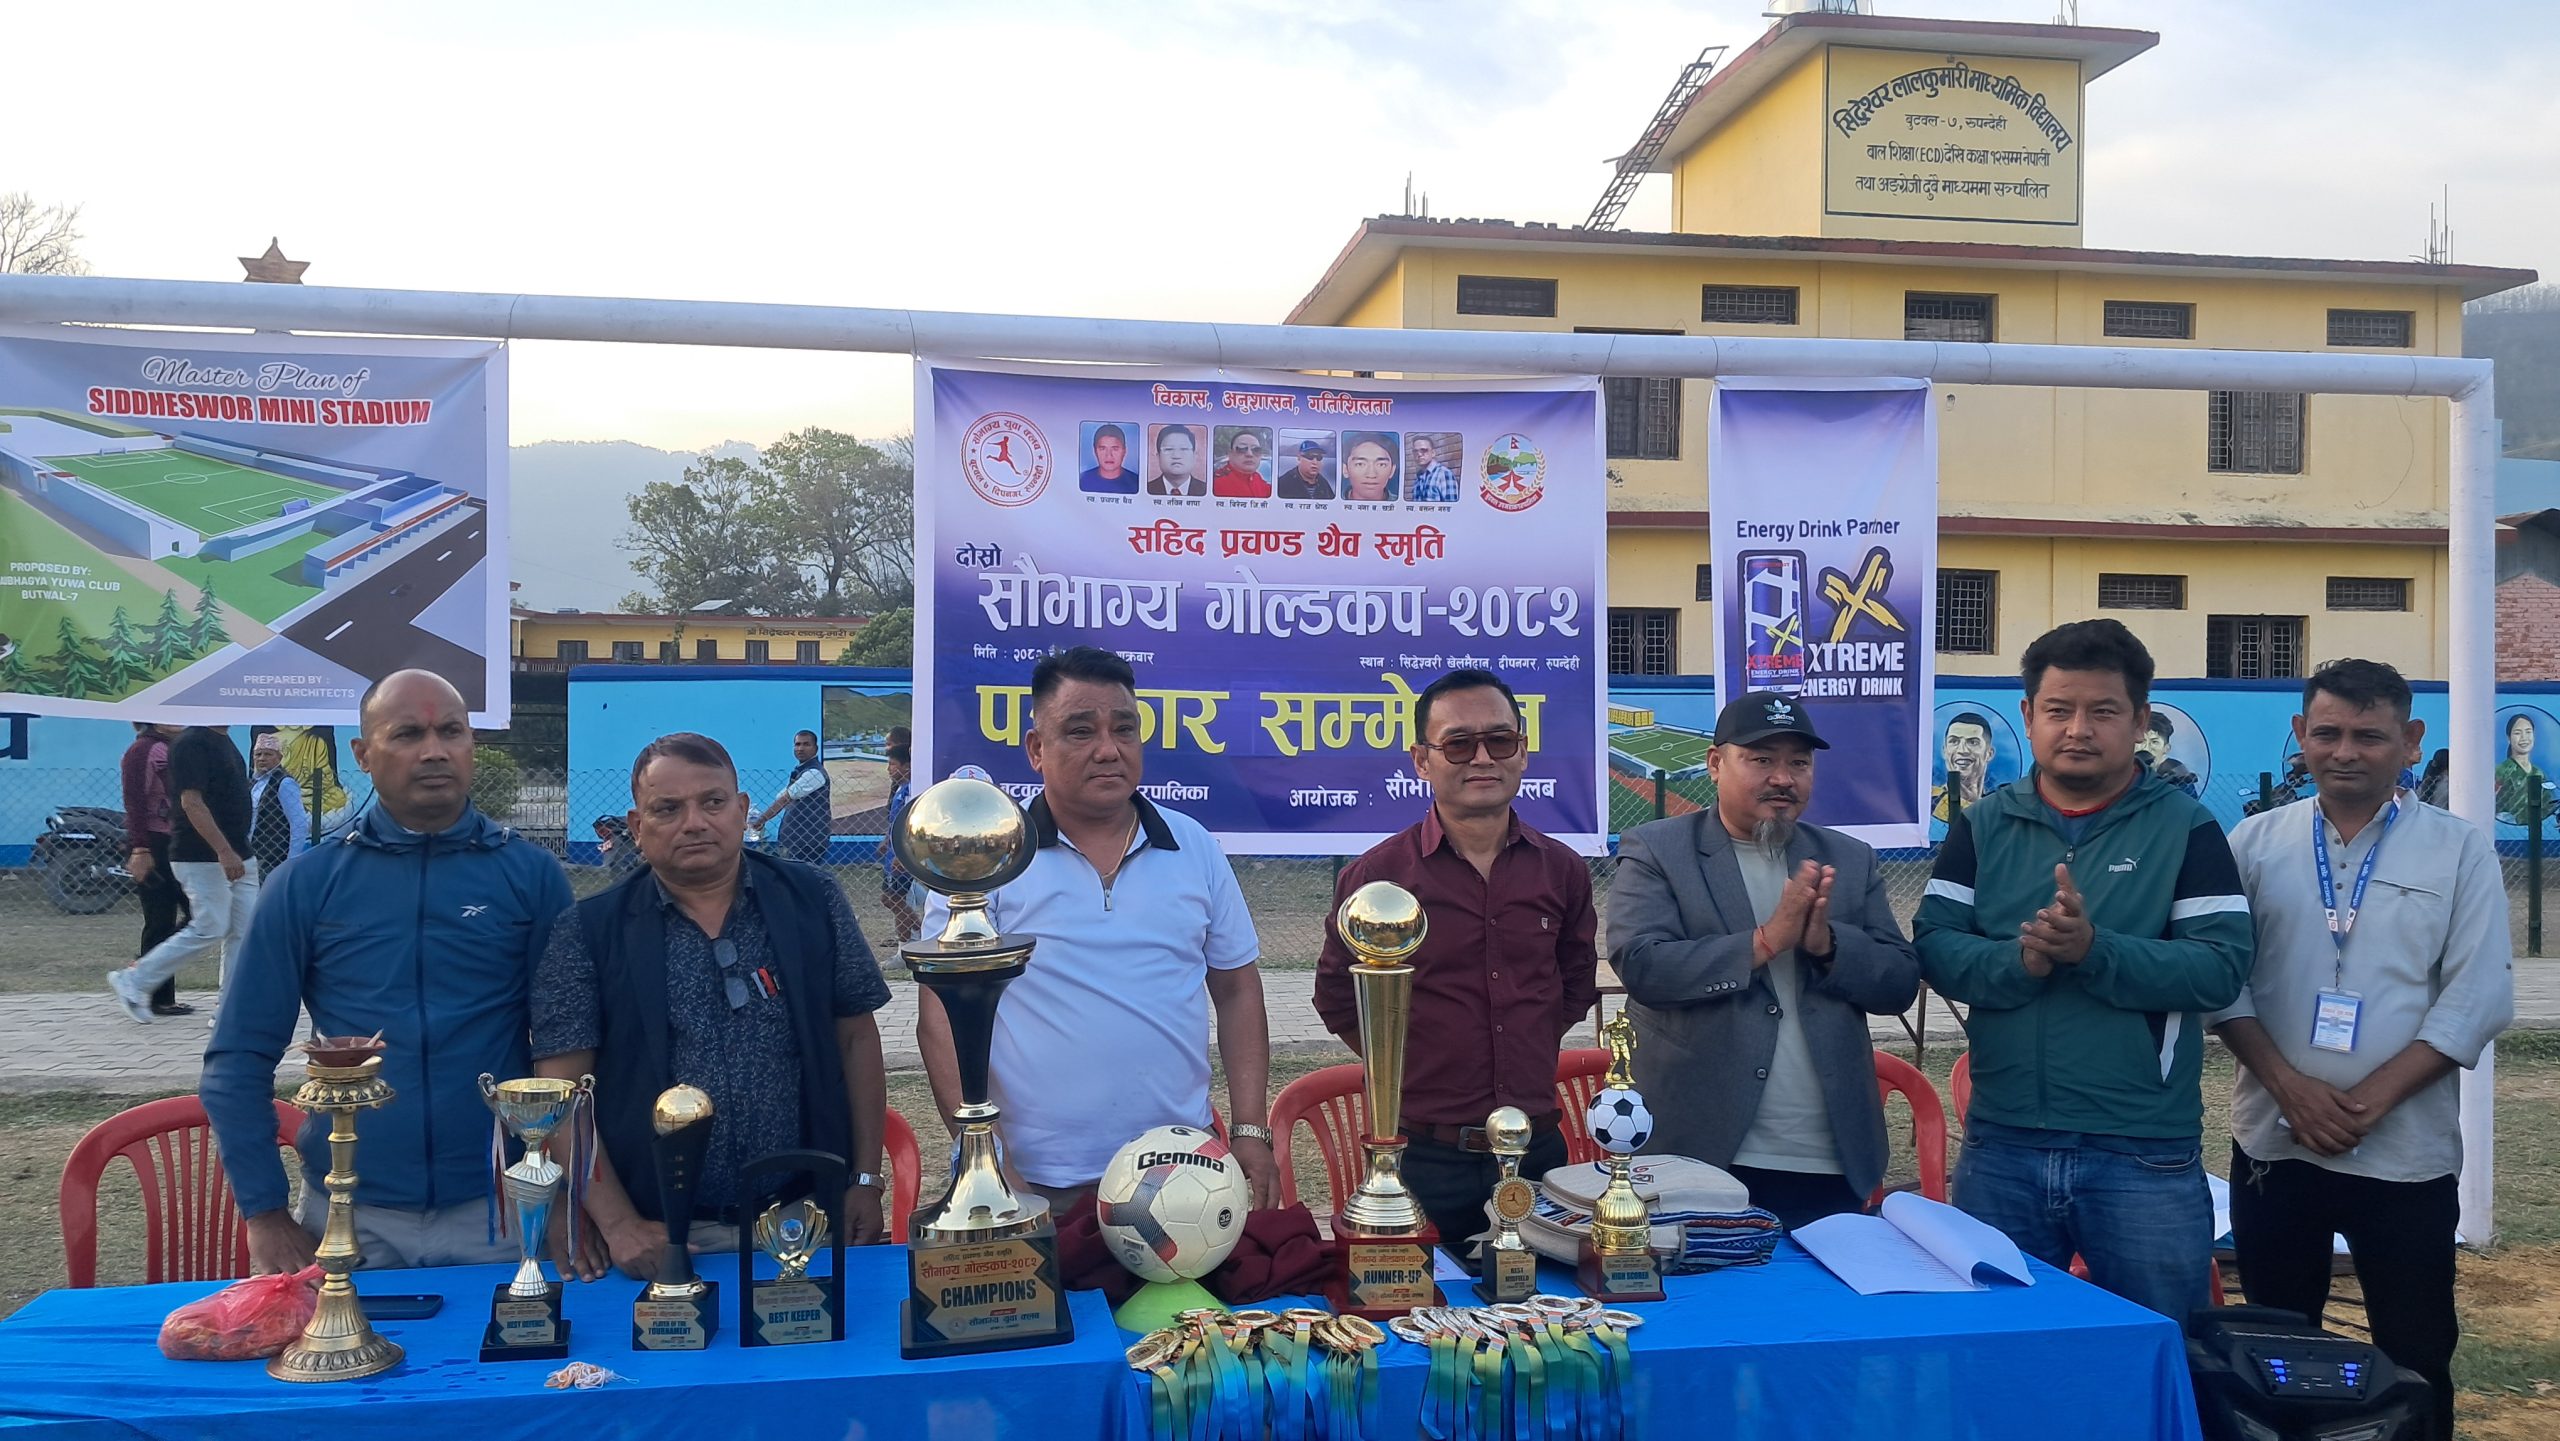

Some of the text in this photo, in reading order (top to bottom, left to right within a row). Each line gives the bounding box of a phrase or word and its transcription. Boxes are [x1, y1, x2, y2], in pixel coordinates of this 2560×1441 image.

[1890, 61, 1969, 98] लालकुमारी
[1968, 70, 2032, 110] माध्यमिक
[2025, 93, 2073, 154] विद्यालय
[1856, 176, 1876, 192] तथा
[143, 356, 369, 396] Master Plan of
[88, 387, 432, 425] SIDDHESWOR MINI STADIUM
[1152, 384, 1393, 416] विकास, अनुशासन, गतिशिलता
[1736, 519, 1795, 542] Energy
[1799, 519, 1843, 538] Drink
[1127, 518, 1446, 566] सहिद प्रचण्ड थैव स्मृति
[10, 562, 92, 576] PROPOSED BY:
[51, 577, 86, 589] YUWA
[88, 581, 121, 592] CLUB
[978, 552, 1581, 638] सौभाग्य गोल्डकप-२०८२
[21, 590, 79, 602] BUTWAL-7
[973, 643, 998, 660] मिति
[1747, 653, 1803, 669] XTREME
[1807, 641, 1905, 673] XTREME
[1359, 656, 1385, 669] स्थान
[243, 675, 306, 685] PREPARED
[308, 675, 323, 684] BY
[1800, 677, 1903, 698] ENERGY DRINK
[219, 687, 356, 698] SUVAASTU ARCHITECTS
[1289, 785, 1359, 807] आयोजक
[1137, 1150, 1225, 1174] Gemma
[1363, 1269, 1422, 1284] RUNNER-UP
[940, 1278, 1037, 1309] CHAMPIONS
[768, 1309, 821, 1324] BEST KEEPER
